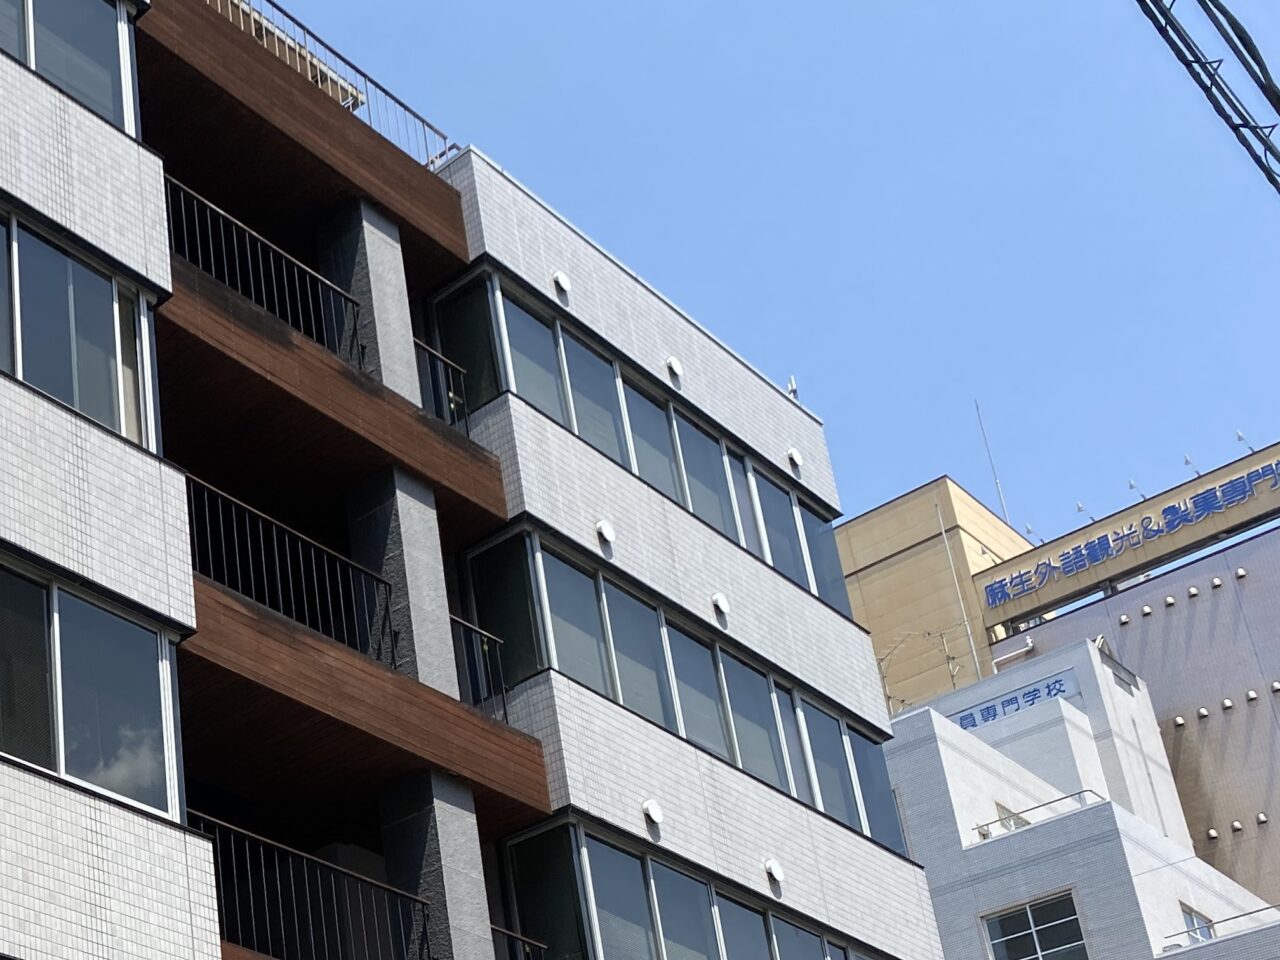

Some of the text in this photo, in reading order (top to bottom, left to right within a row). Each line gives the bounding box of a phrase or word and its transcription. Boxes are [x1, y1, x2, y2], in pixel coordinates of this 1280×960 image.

[984, 459, 1280, 608] 麻生外語観光&製菓専門
